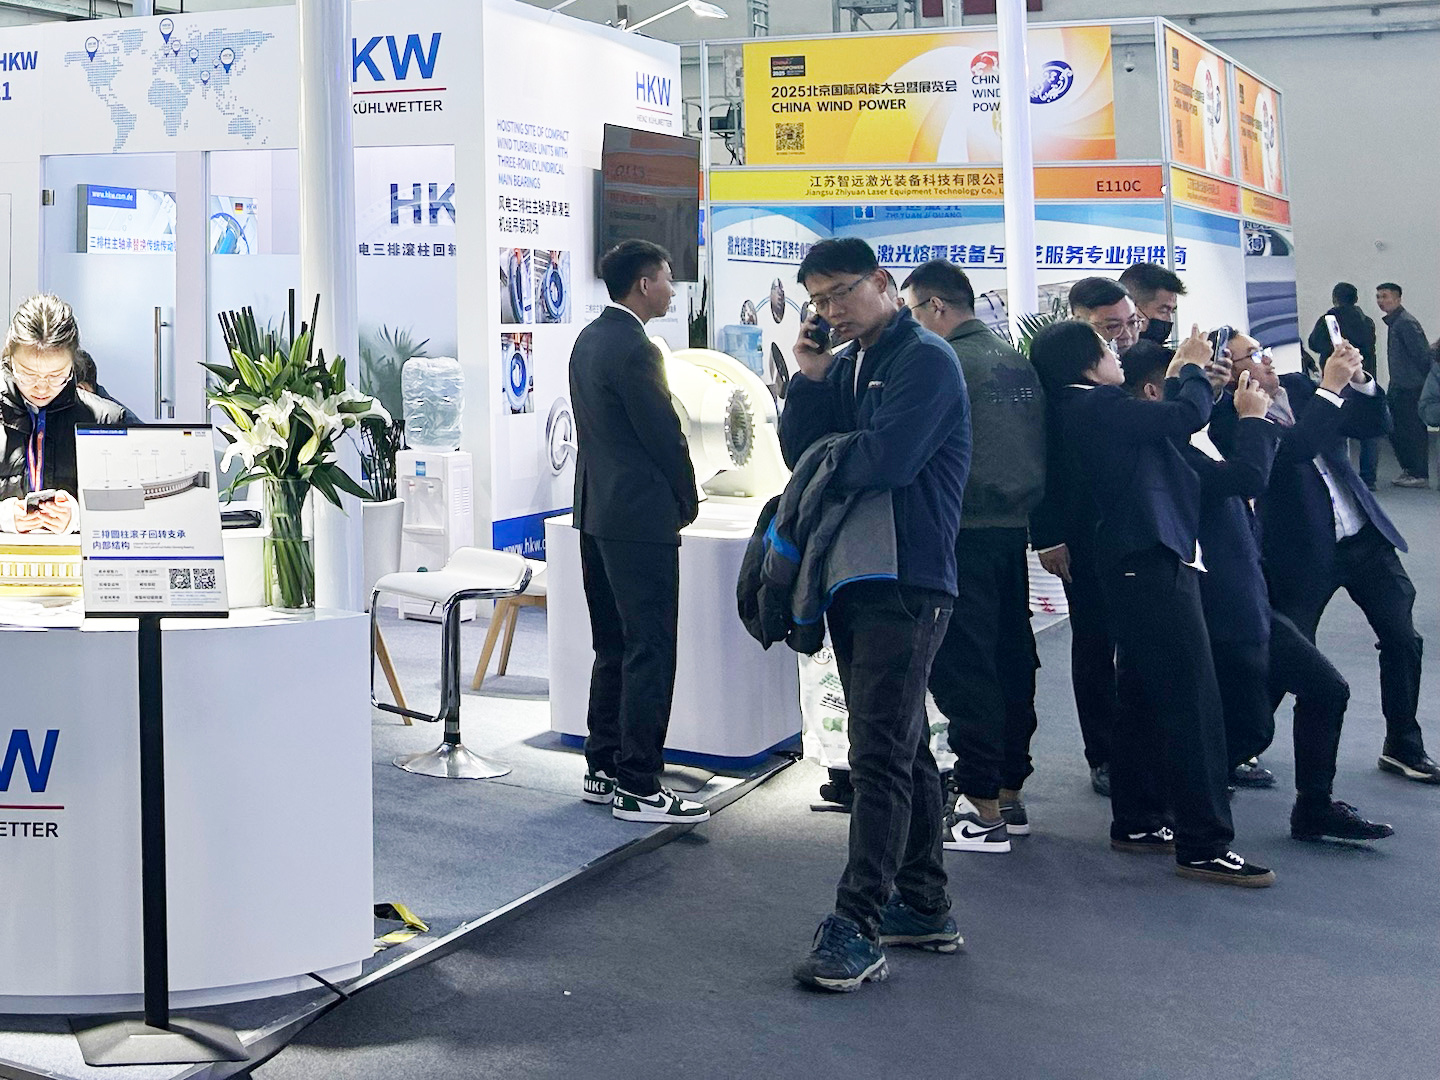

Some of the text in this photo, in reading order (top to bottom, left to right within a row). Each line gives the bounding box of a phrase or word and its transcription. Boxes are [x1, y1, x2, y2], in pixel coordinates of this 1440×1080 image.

[352, 32, 442, 83] KW
[972, 75, 999, 85] CHIN
[636, 71, 671, 107] HKW
[771, 80, 958, 98] 2025北京国际风能大会暨展览会
[772, 99, 906, 113] CHINA WIND POWER
[973, 102, 1000, 112] POW
[497, 119, 569, 142] HOISTING SITE OF COMPACT
[497, 137, 512, 150] WIND
[513, 139, 537, 154] TURBINE
[498, 173, 541, 189] MAIN BEARINGS
[1096, 179, 1141, 193] E110C
[805, 188, 834, 197] Jiangsu
[835, 188, 865, 197] Zhiyuan
[890, 187, 932, 196] Equipment
[935, 187, 979, 196] Technology
[390, 182, 456, 225] HK
